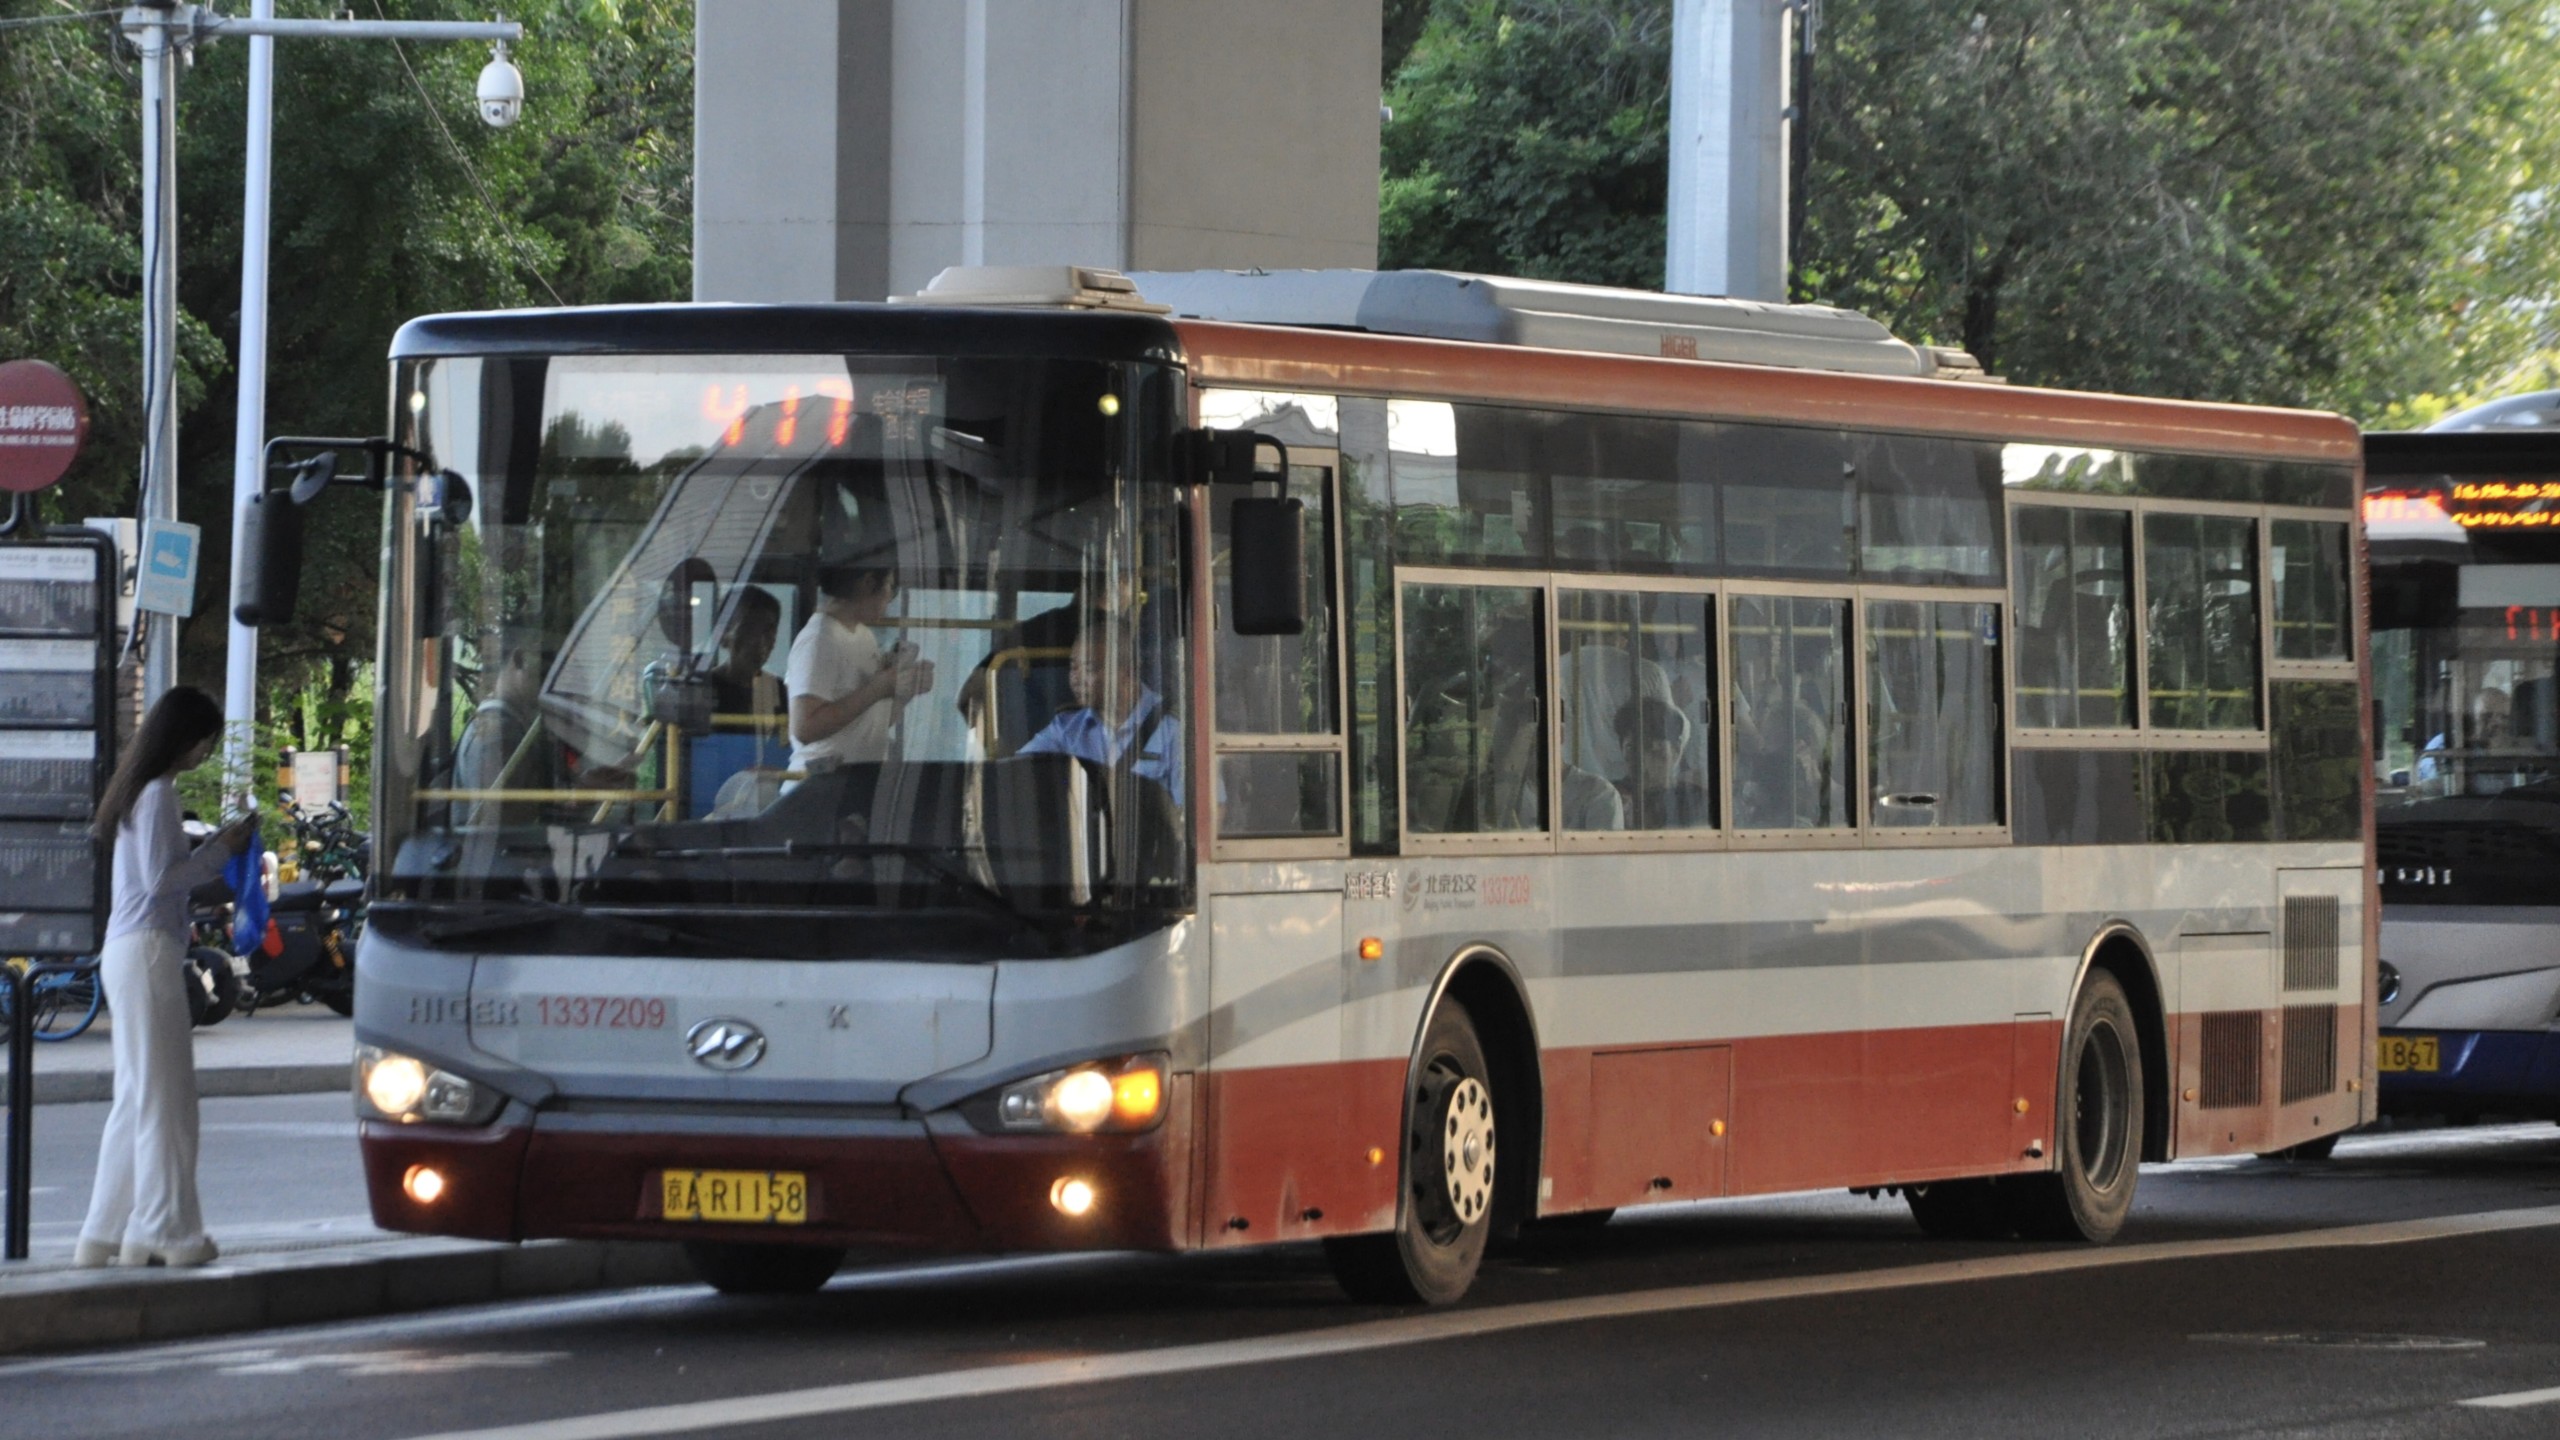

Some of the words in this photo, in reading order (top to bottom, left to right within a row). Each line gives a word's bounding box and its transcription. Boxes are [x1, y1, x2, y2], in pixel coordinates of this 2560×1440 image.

[1660, 334, 1698, 359] HIGER
[703, 377, 852, 447] 417
[1425, 873, 1477, 894] 北京公交
[1482, 874, 1530, 906] 1337209
[408, 997, 520, 1025] HIGER
[537, 996, 666, 1028] 1337209
[829, 1004, 849, 1029] K
